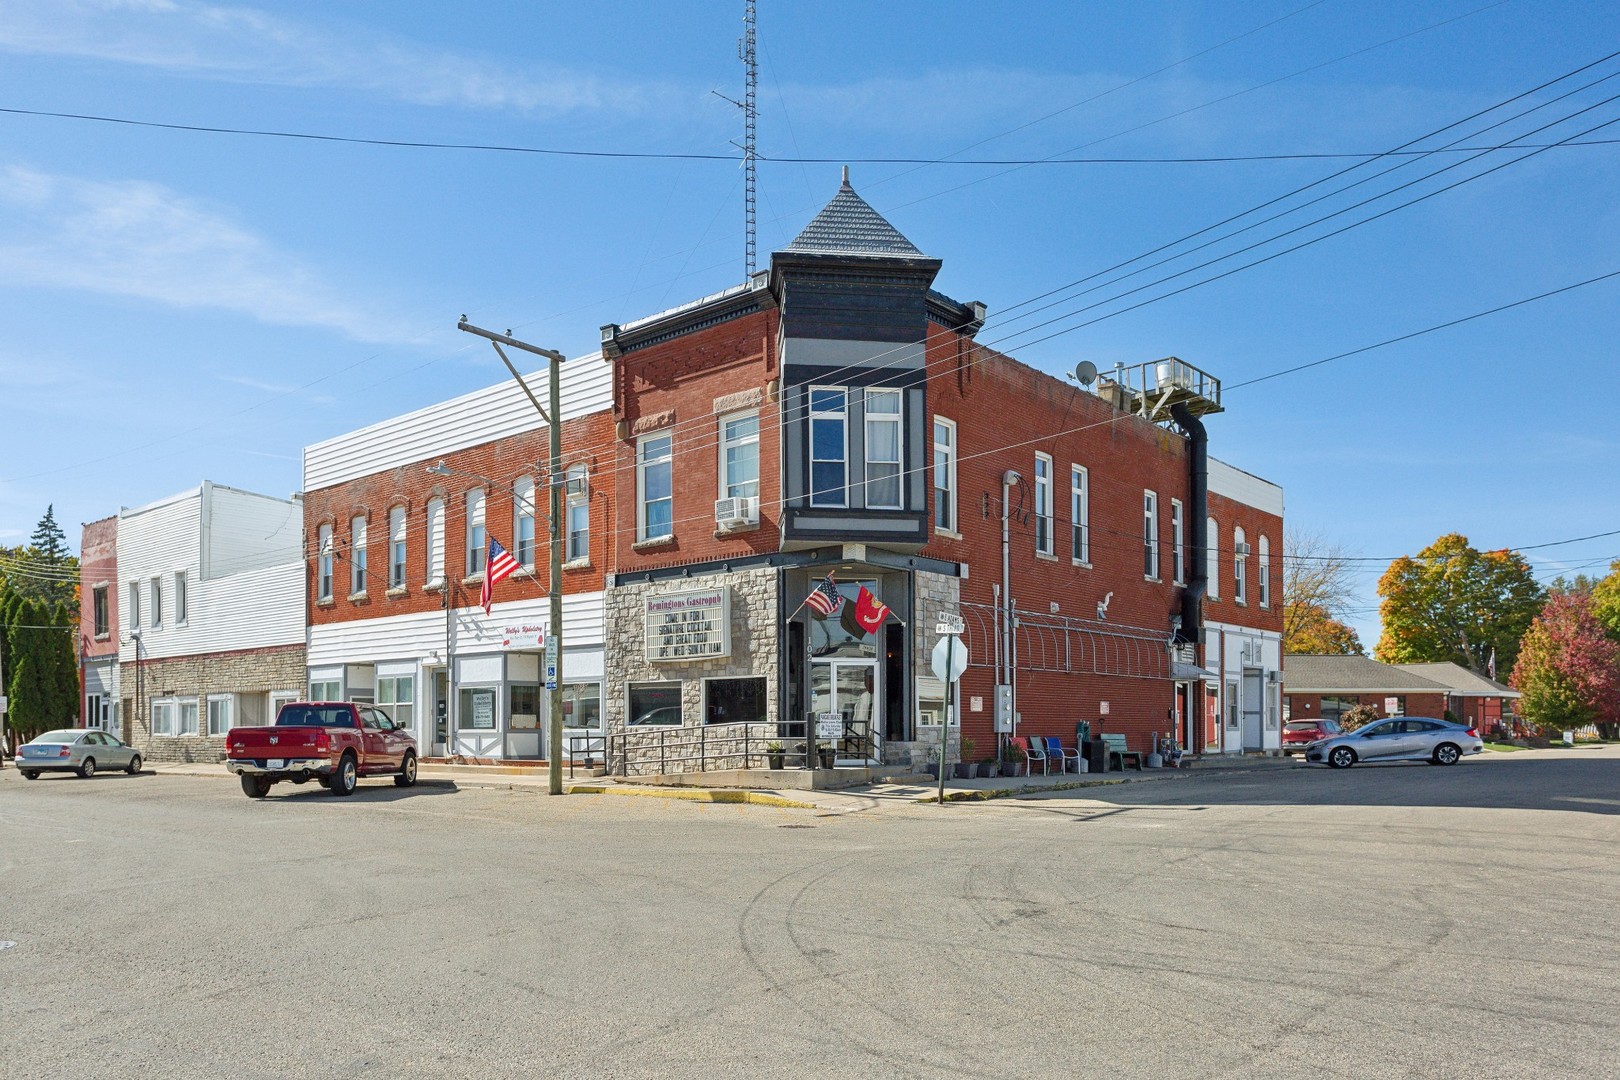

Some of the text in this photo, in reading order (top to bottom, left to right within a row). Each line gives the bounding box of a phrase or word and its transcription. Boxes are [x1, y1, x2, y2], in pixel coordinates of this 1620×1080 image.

[648, 593, 721, 611] Remingtons Gastropub
[665, 610, 705, 623] COME IN FOR A
[659, 621, 712, 635] SIGNATURE COCKTAIL
[664, 632, 708, 645] AND GREAT FOOD
